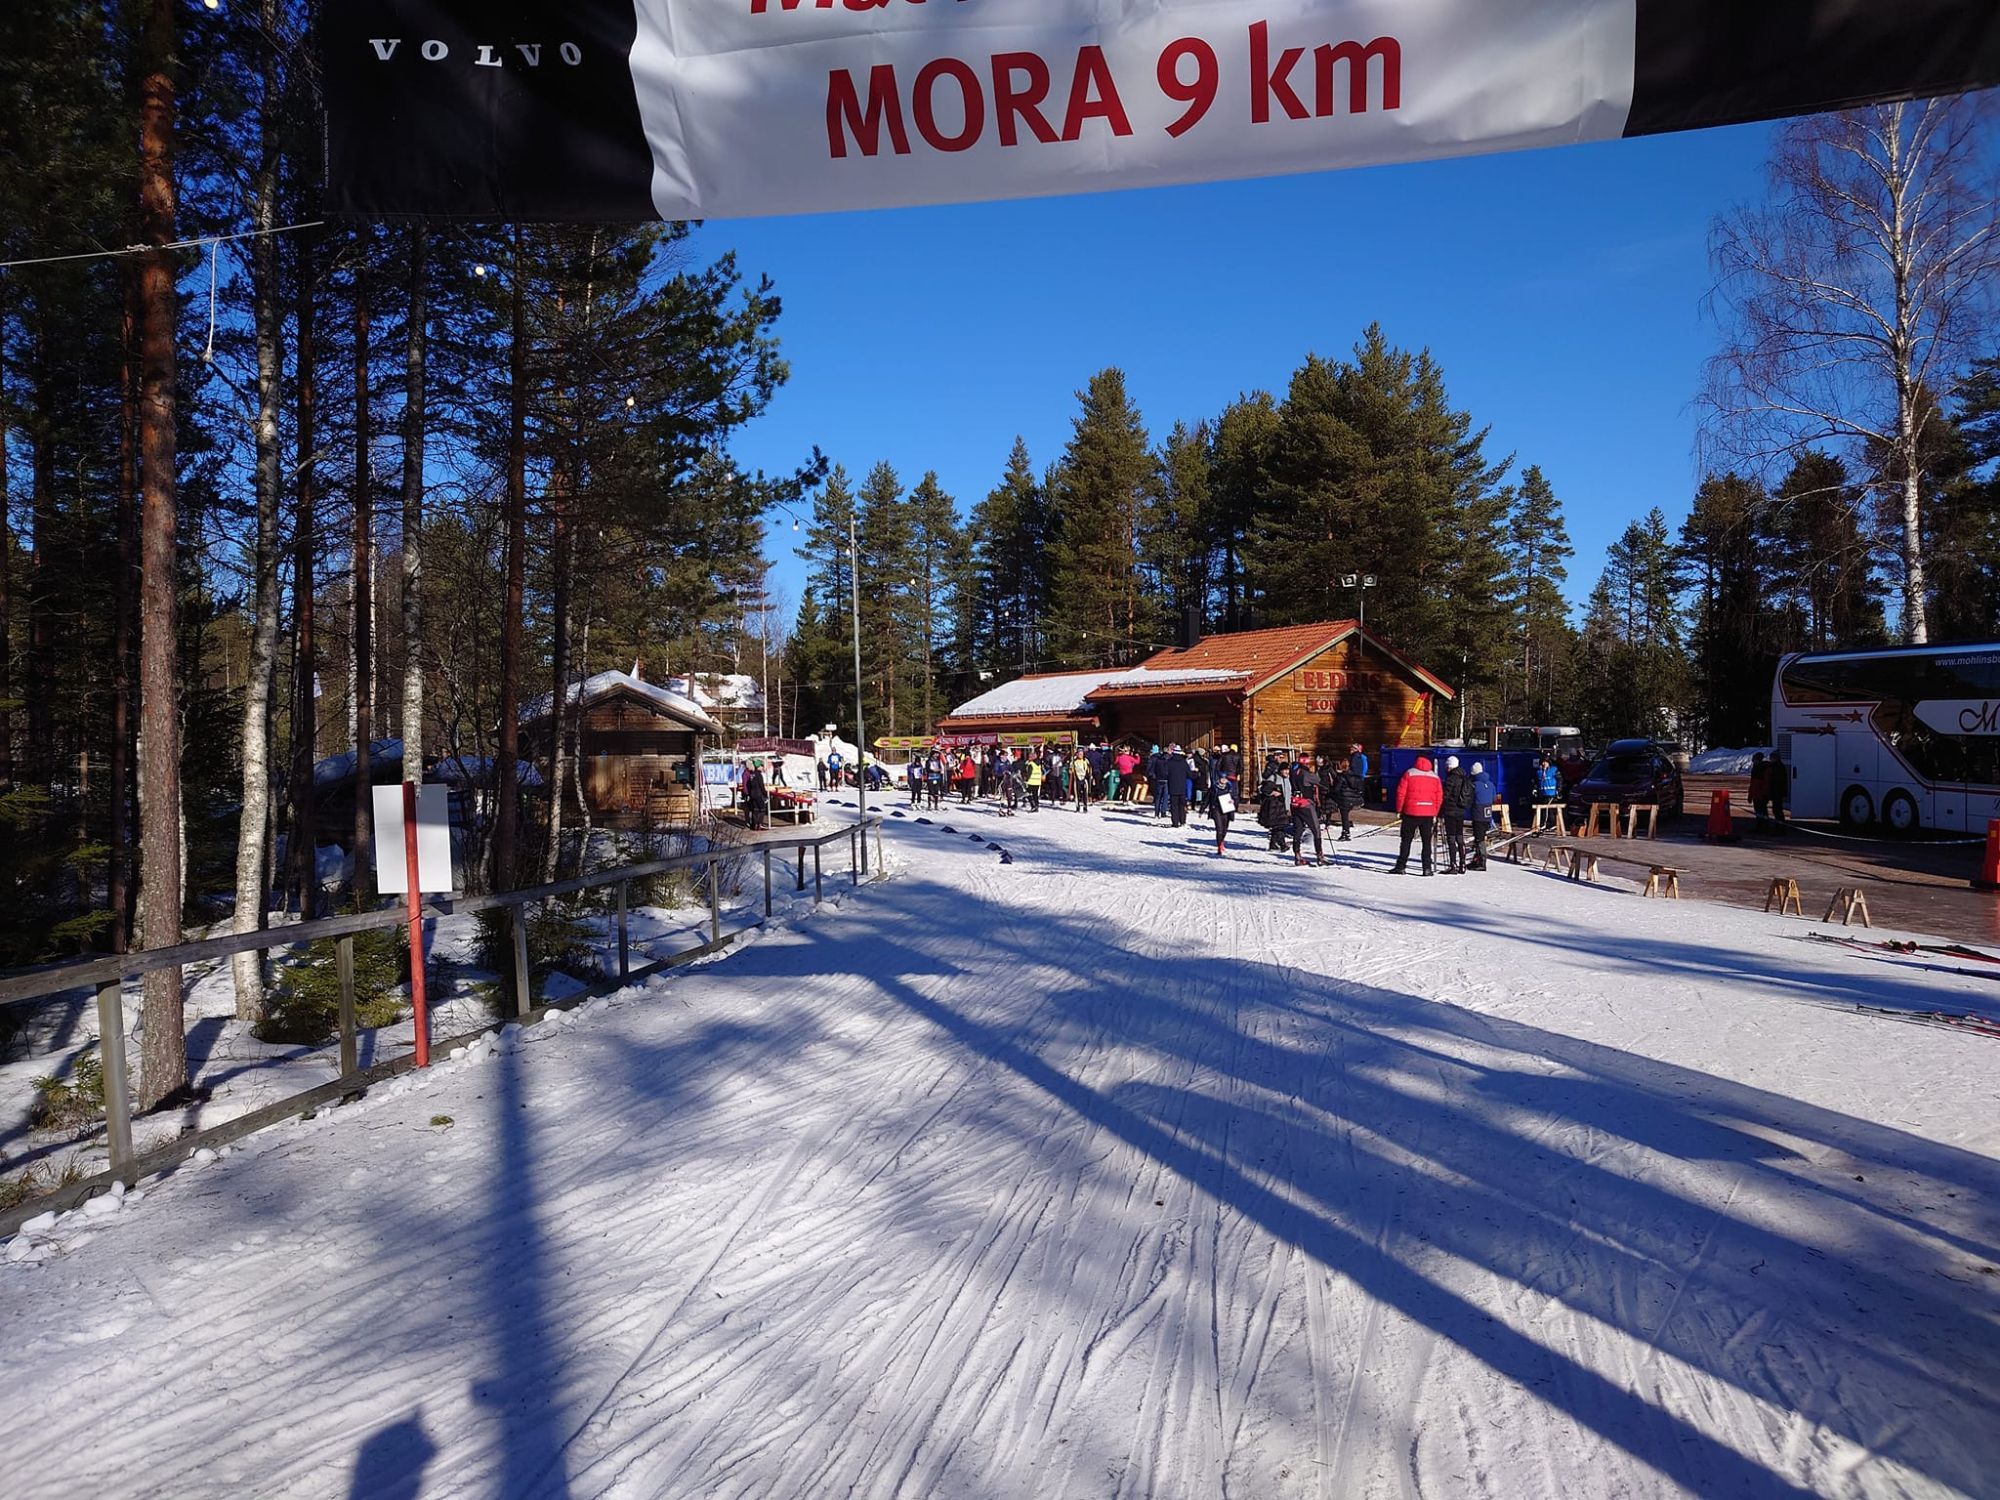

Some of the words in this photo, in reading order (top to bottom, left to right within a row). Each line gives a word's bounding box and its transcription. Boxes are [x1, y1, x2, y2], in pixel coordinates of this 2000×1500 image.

[369, 38, 583, 67] VOLVO
[828, 46, 1133, 158] MORA
[1157, 36, 1219, 137] 9
[1249, 21, 1402, 124] km
[1303, 671, 1381, 690] ELDRIS
